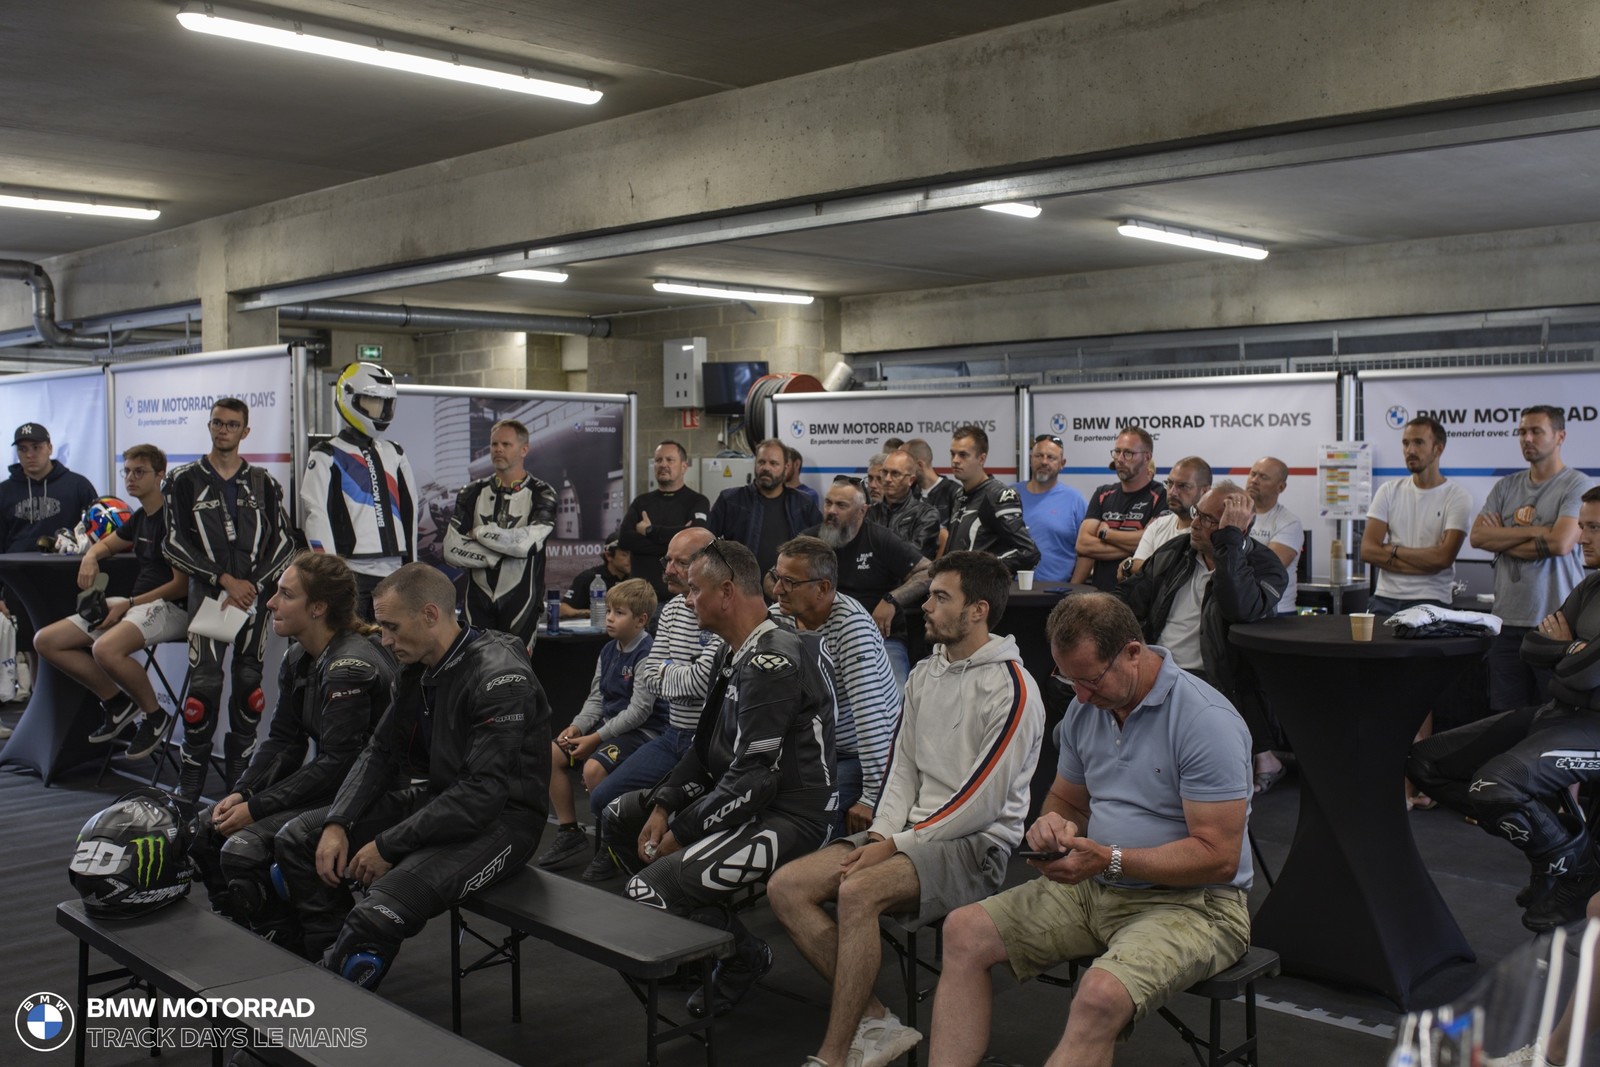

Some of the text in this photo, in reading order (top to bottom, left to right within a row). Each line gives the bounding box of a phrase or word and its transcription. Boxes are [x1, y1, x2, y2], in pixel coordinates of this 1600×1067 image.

[137, 399, 160, 414] BMW
[161, 396, 214, 413] MOTORRAD
[250, 391, 276, 408] DAYS
[1073, 412, 1312, 430] BMW MOTORRAD TRACK DAYS
[1474, 406, 1598, 423] MOTAD
[809, 423, 839, 435] BMW
[842, 421, 913, 435] MOTORRAD
[917, 421, 959, 434] TRACK
[1487, 430, 1510, 438] avec
[818, 437, 850, 447] partenariat
[1073, 434, 1083, 442] En
[373, 502, 386, 528] BMW
[450, 546, 487, 562] DAINESE
[561, 544, 573, 556] M
[573, 543, 602, 556] 1000
[485, 673, 527, 692] RST
[69, 840, 127, 876] 20
[458, 844, 512, 900] RST
[373, 904, 405, 925] RST
